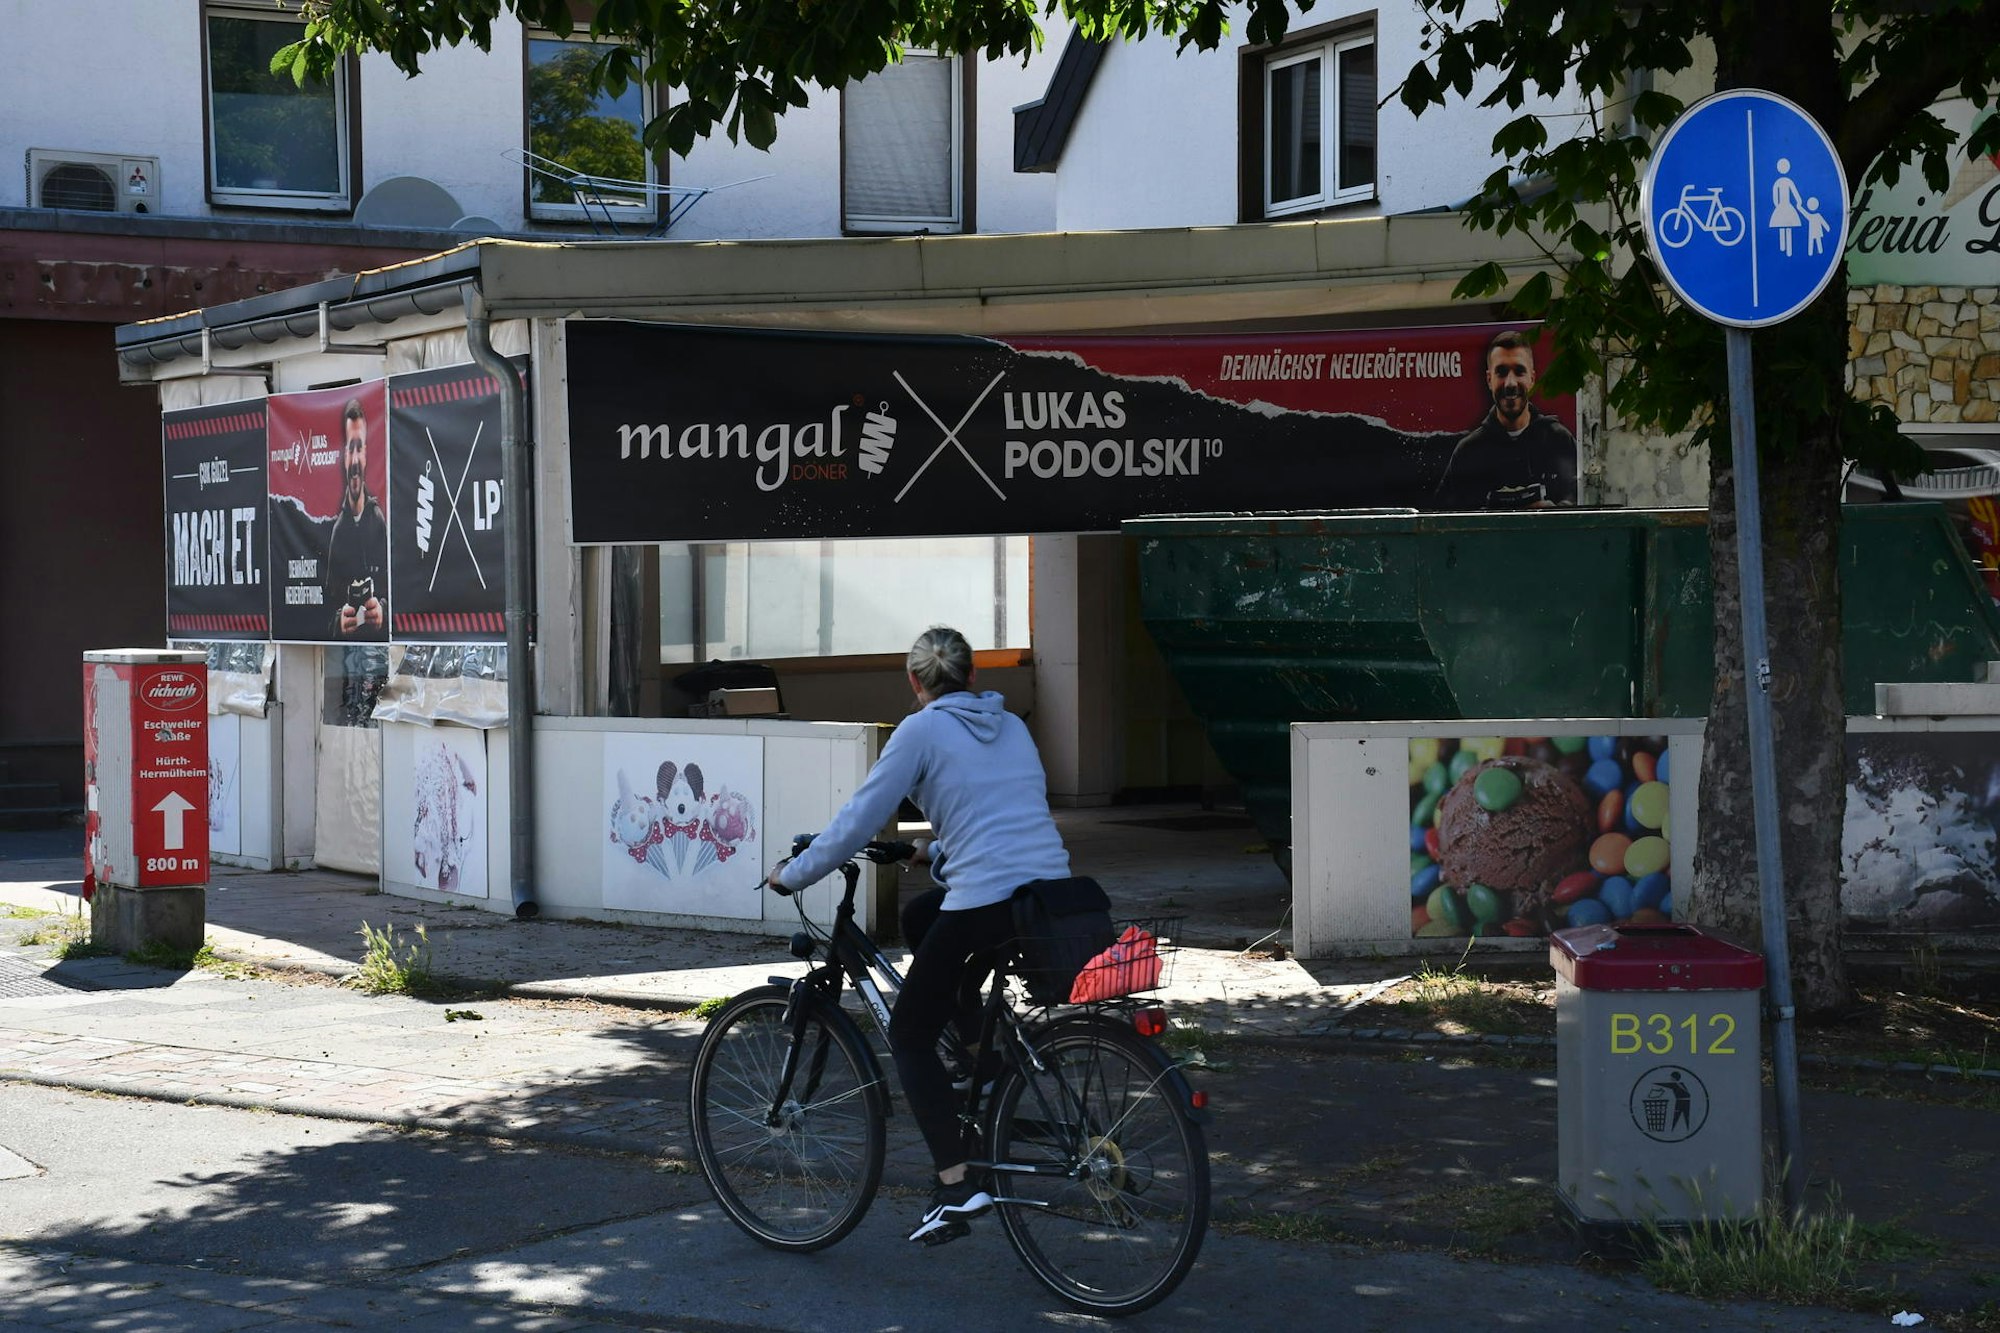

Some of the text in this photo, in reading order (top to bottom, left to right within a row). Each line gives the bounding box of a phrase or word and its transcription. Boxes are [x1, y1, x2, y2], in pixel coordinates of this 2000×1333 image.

[1847, 189, 1950, 254] teria
[1220, 347, 1462, 381] DEMNÄCHST NEUERÖFFNUNG
[616, 404, 849, 491] mangal
[1003, 390, 1127, 430] LUKAS
[1004, 438, 1200, 479] PODOLSKI
[792, 460, 848, 480] DÖNER
[473, 479, 505, 531] LP
[173, 507, 260, 586] MACH ET.
[161, 674, 185, 682] REWE
[148, 682, 197, 698] richrath
[143, 719, 202, 730] Eschweiler
[154, 731, 192, 743] Saße
[155, 756, 191, 767] Hürth-
[140, 767, 207, 779] Hermülheim
[146, 857, 199, 872] 800 m
[1610, 1012, 1737, 1055] B312
